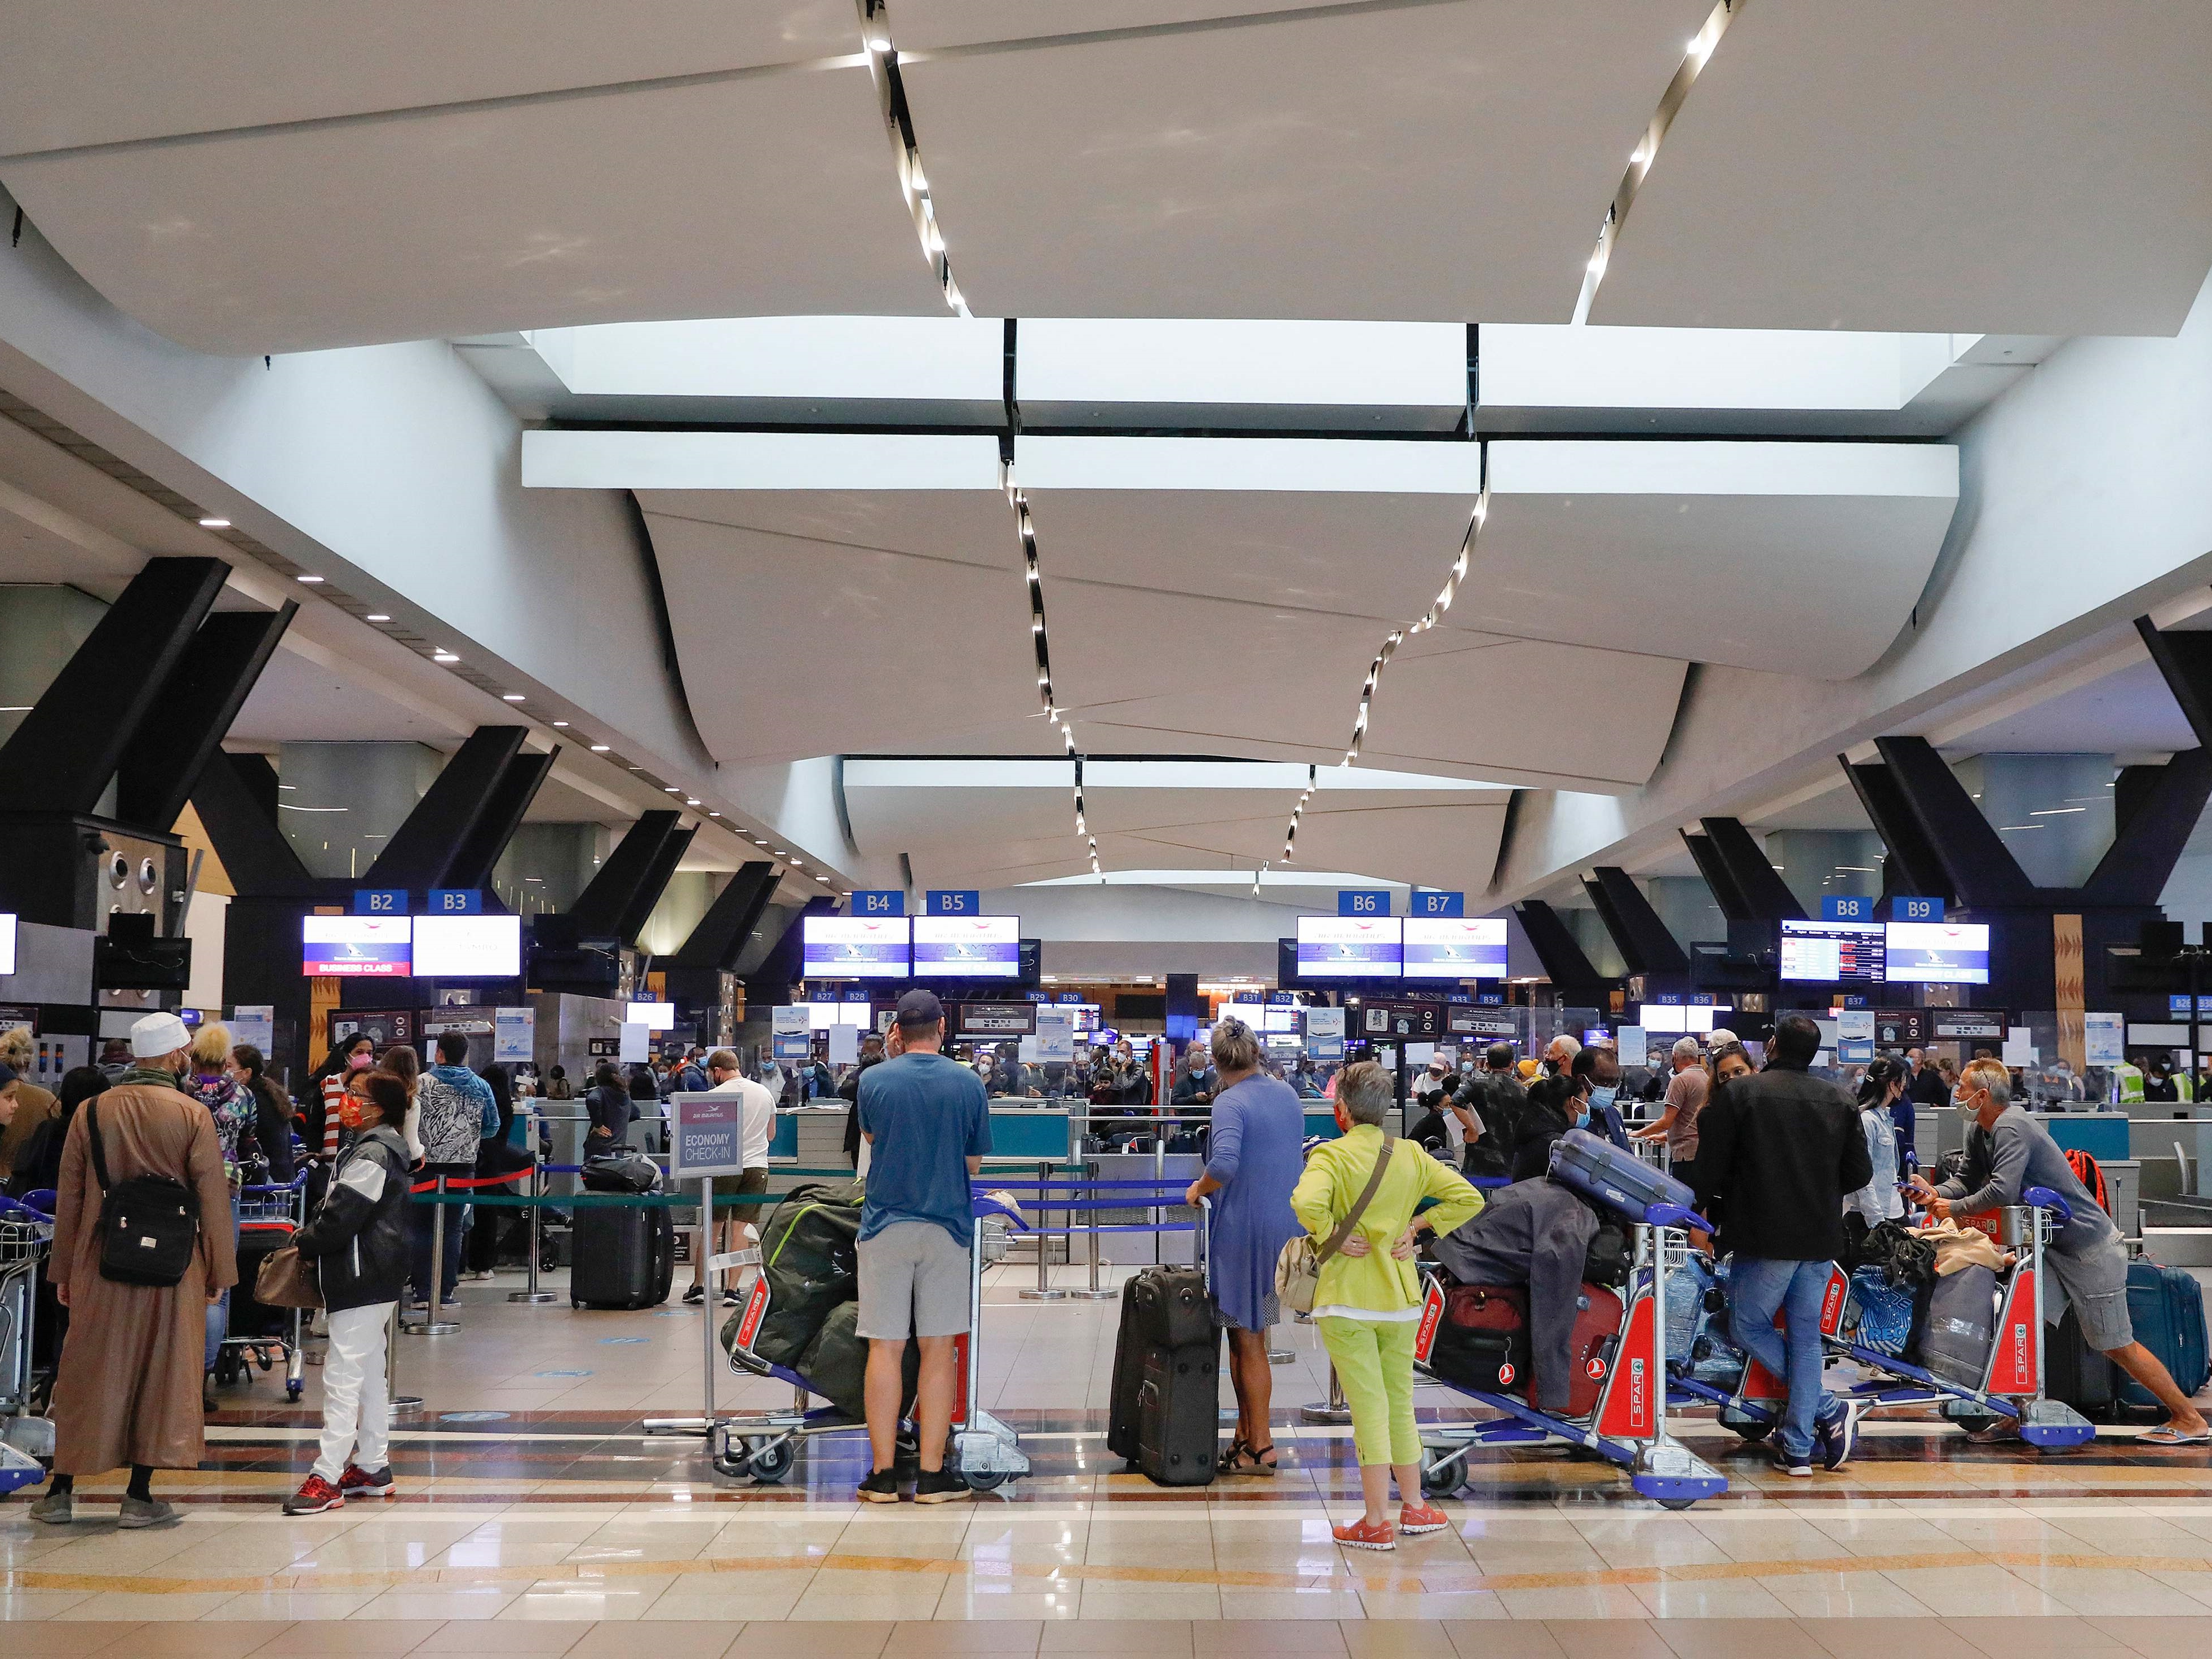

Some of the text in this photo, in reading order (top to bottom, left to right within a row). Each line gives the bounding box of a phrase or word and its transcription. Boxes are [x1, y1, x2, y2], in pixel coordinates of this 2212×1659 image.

[370, 894, 393, 910] B2
[444, 894, 466, 910] B3
[867, 895, 890, 911] B4
[942, 895, 964, 910] B5
[1354, 895, 1376, 911] B6
[1427, 896, 1449, 912] B7
[1837, 901, 1859, 916] B8
[1908, 901, 1930, 917] B9
[319, 964, 392, 973] BUSINESS CLASS
[685, 1133, 730, 1146] ECONOMY
[685, 1146, 730, 1161] CHECK-IN
[1965, 1219, 1987, 1229] SPAR
[1825, 1294, 1837, 1320] SPAR
[745, 1303, 757, 1331] SPAR
[1420, 1315, 1433, 1344] SPAR
